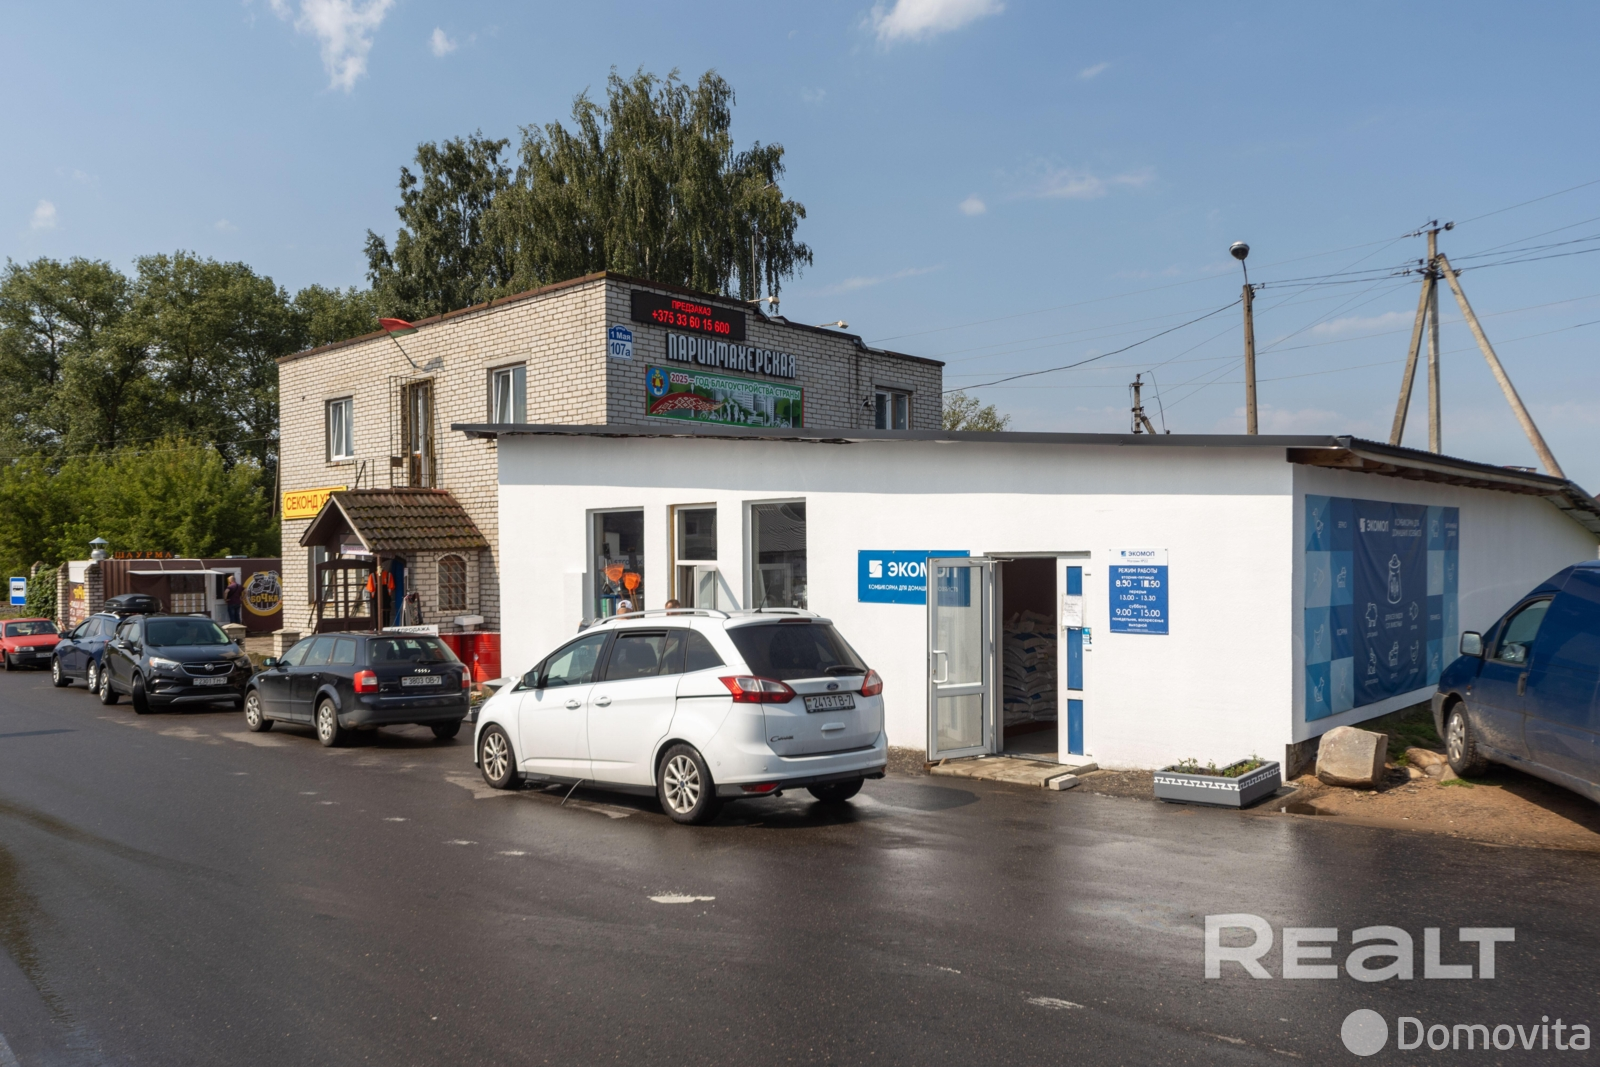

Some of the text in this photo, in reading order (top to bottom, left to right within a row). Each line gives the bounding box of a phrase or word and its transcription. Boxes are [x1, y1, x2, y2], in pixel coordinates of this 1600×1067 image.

[672, 300, 712, 316] ПРЕДЗАКАЗ
[652, 309, 730, 334] +375 33 60 15 600
[616, 332, 630, 340] Мая
[611, 342, 630, 356] 107а
[668, 333, 796, 378] ПАРИКМАХЕРСКАЯ
[670, 372, 688, 384] 2025
[694, 377, 709, 387] ГОД
[711, 379, 774, 396] БЛАГОУСТРОЙСТВА
[775, 388, 800, 399] СТРАНЫ
[286, 494, 318, 510] СЕКОНД
[813, 695, 851, 708] 2413 TB-7
